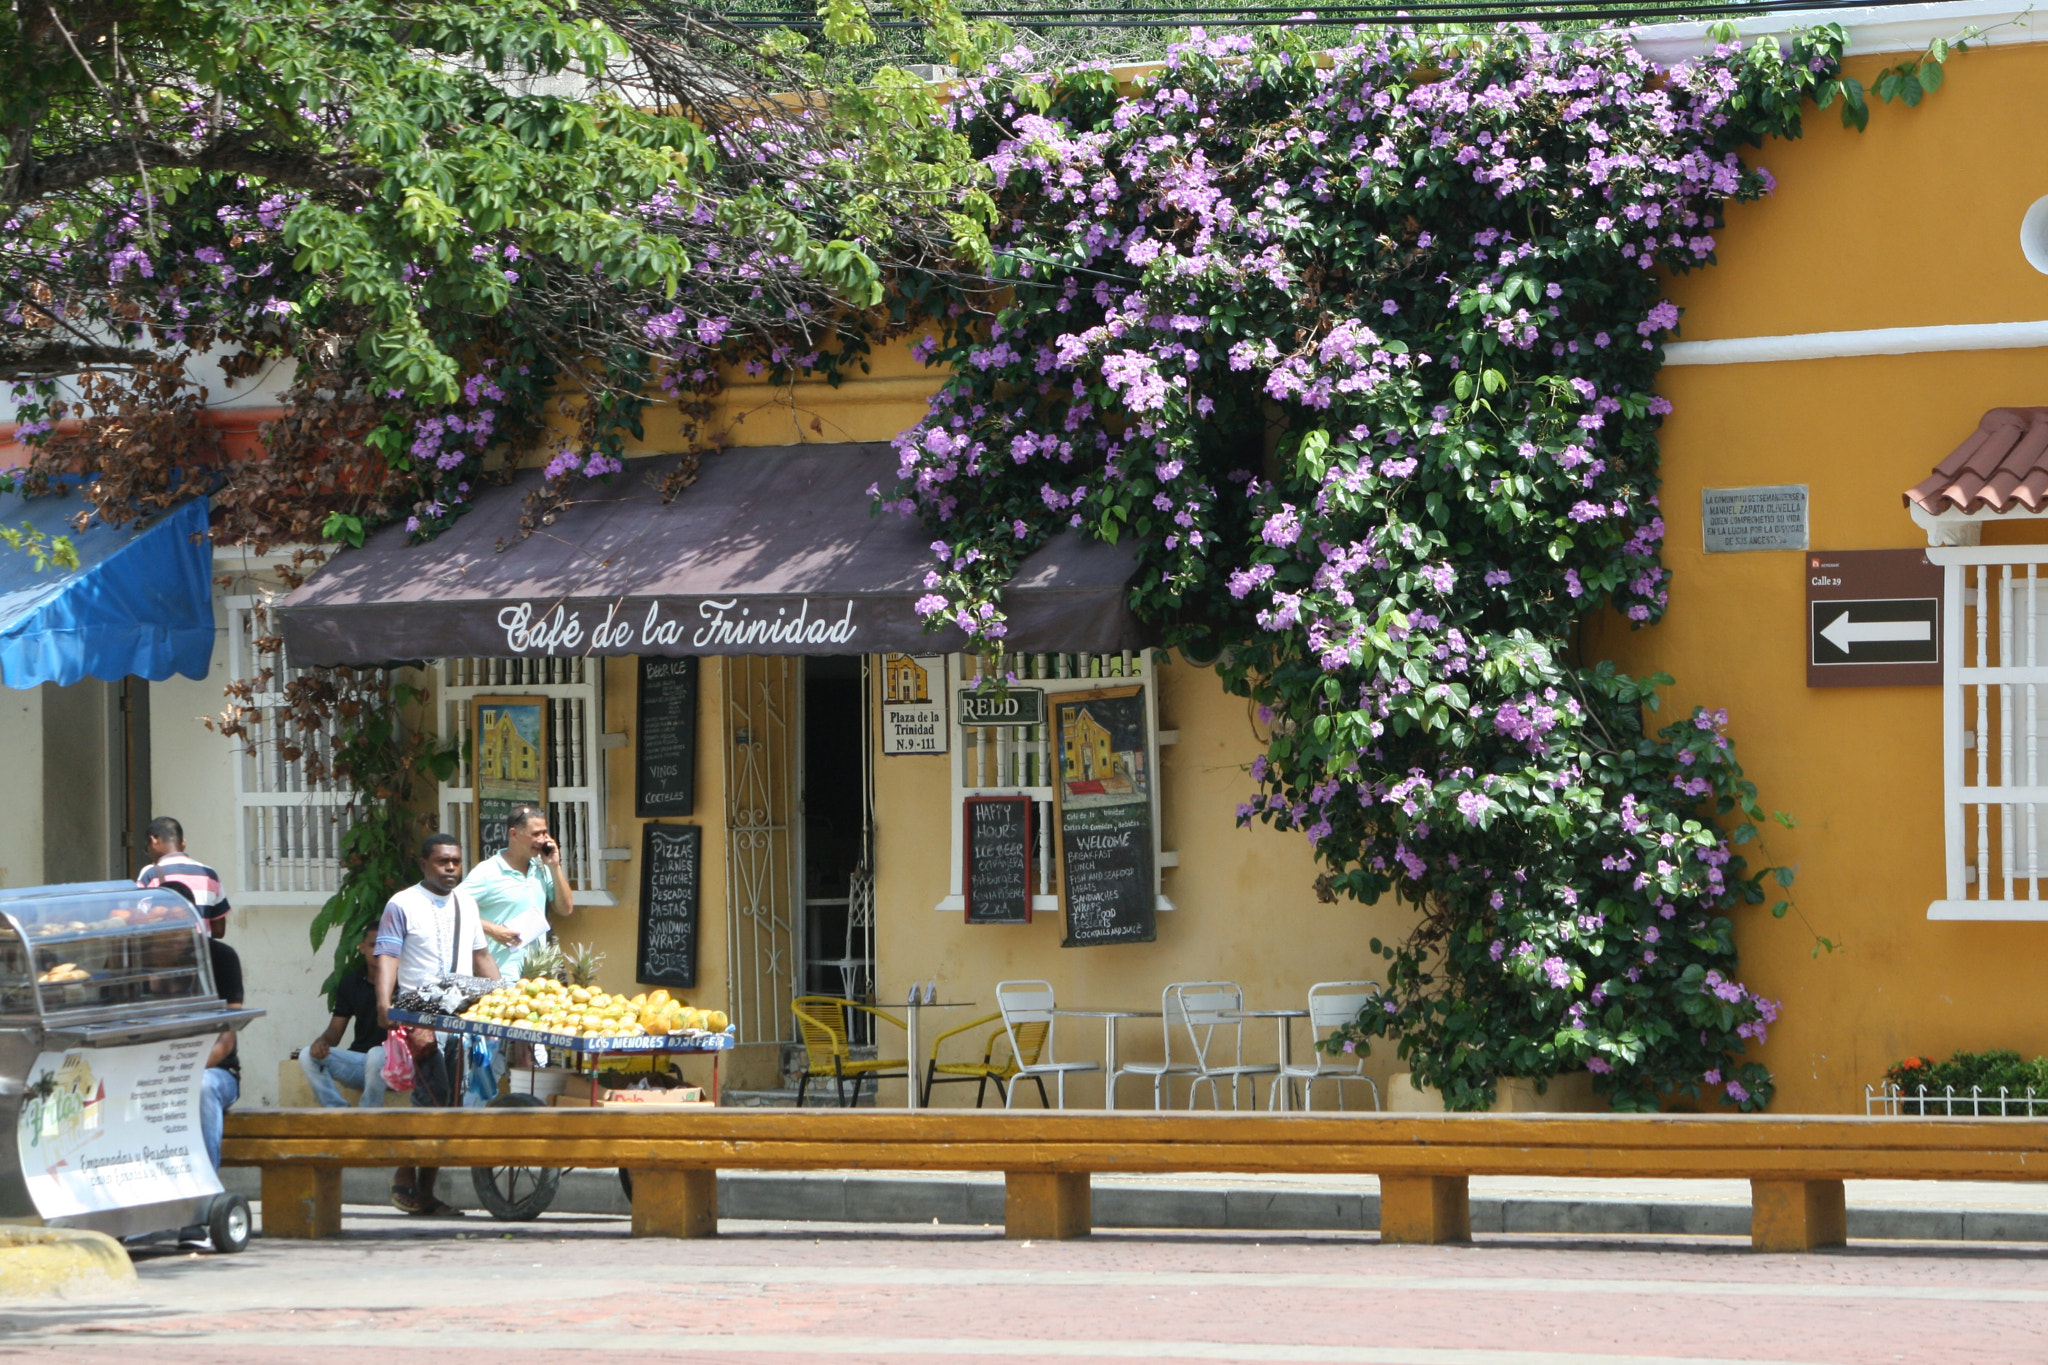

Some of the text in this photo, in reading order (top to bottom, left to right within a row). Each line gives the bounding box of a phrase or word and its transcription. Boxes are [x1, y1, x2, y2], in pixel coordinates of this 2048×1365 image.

[1709, 503, 1801, 516] MANUEL ZAPATA OLIVELLA
[1717, 527, 1726, 536] LA
[1763, 524, 1773, 534] LA
[1811, 575, 1842, 587] Calle 29
[497, 598, 857, 655] Café de la Trinidad
[890, 711, 939, 723] Plaza de la
[895, 724, 934, 736] Trinidad
[649, 765, 678, 779] VINOS
[660, 778, 667, 790] Y
[977, 823, 1018, 839] HOURS
[1076, 831, 1131, 850] WELCOME
[652, 838, 694, 861] PIZZAS
[1067, 849, 1113, 863] BREAKFAST
[1069, 861, 1096, 874] LUNCH
[1069, 874, 1087, 885] FISH
[1088, 870, 1103, 881] AND
[1073, 902, 1102, 914] WRAPS
[648, 934, 688, 951] WRAPS
[442, 1016, 467, 1030] SIGO
[506, 1028, 542, 1043] GRACIAS
[549, 1034, 573, 1047] DIOS
[611, 1035, 665, 1049] MENORES
